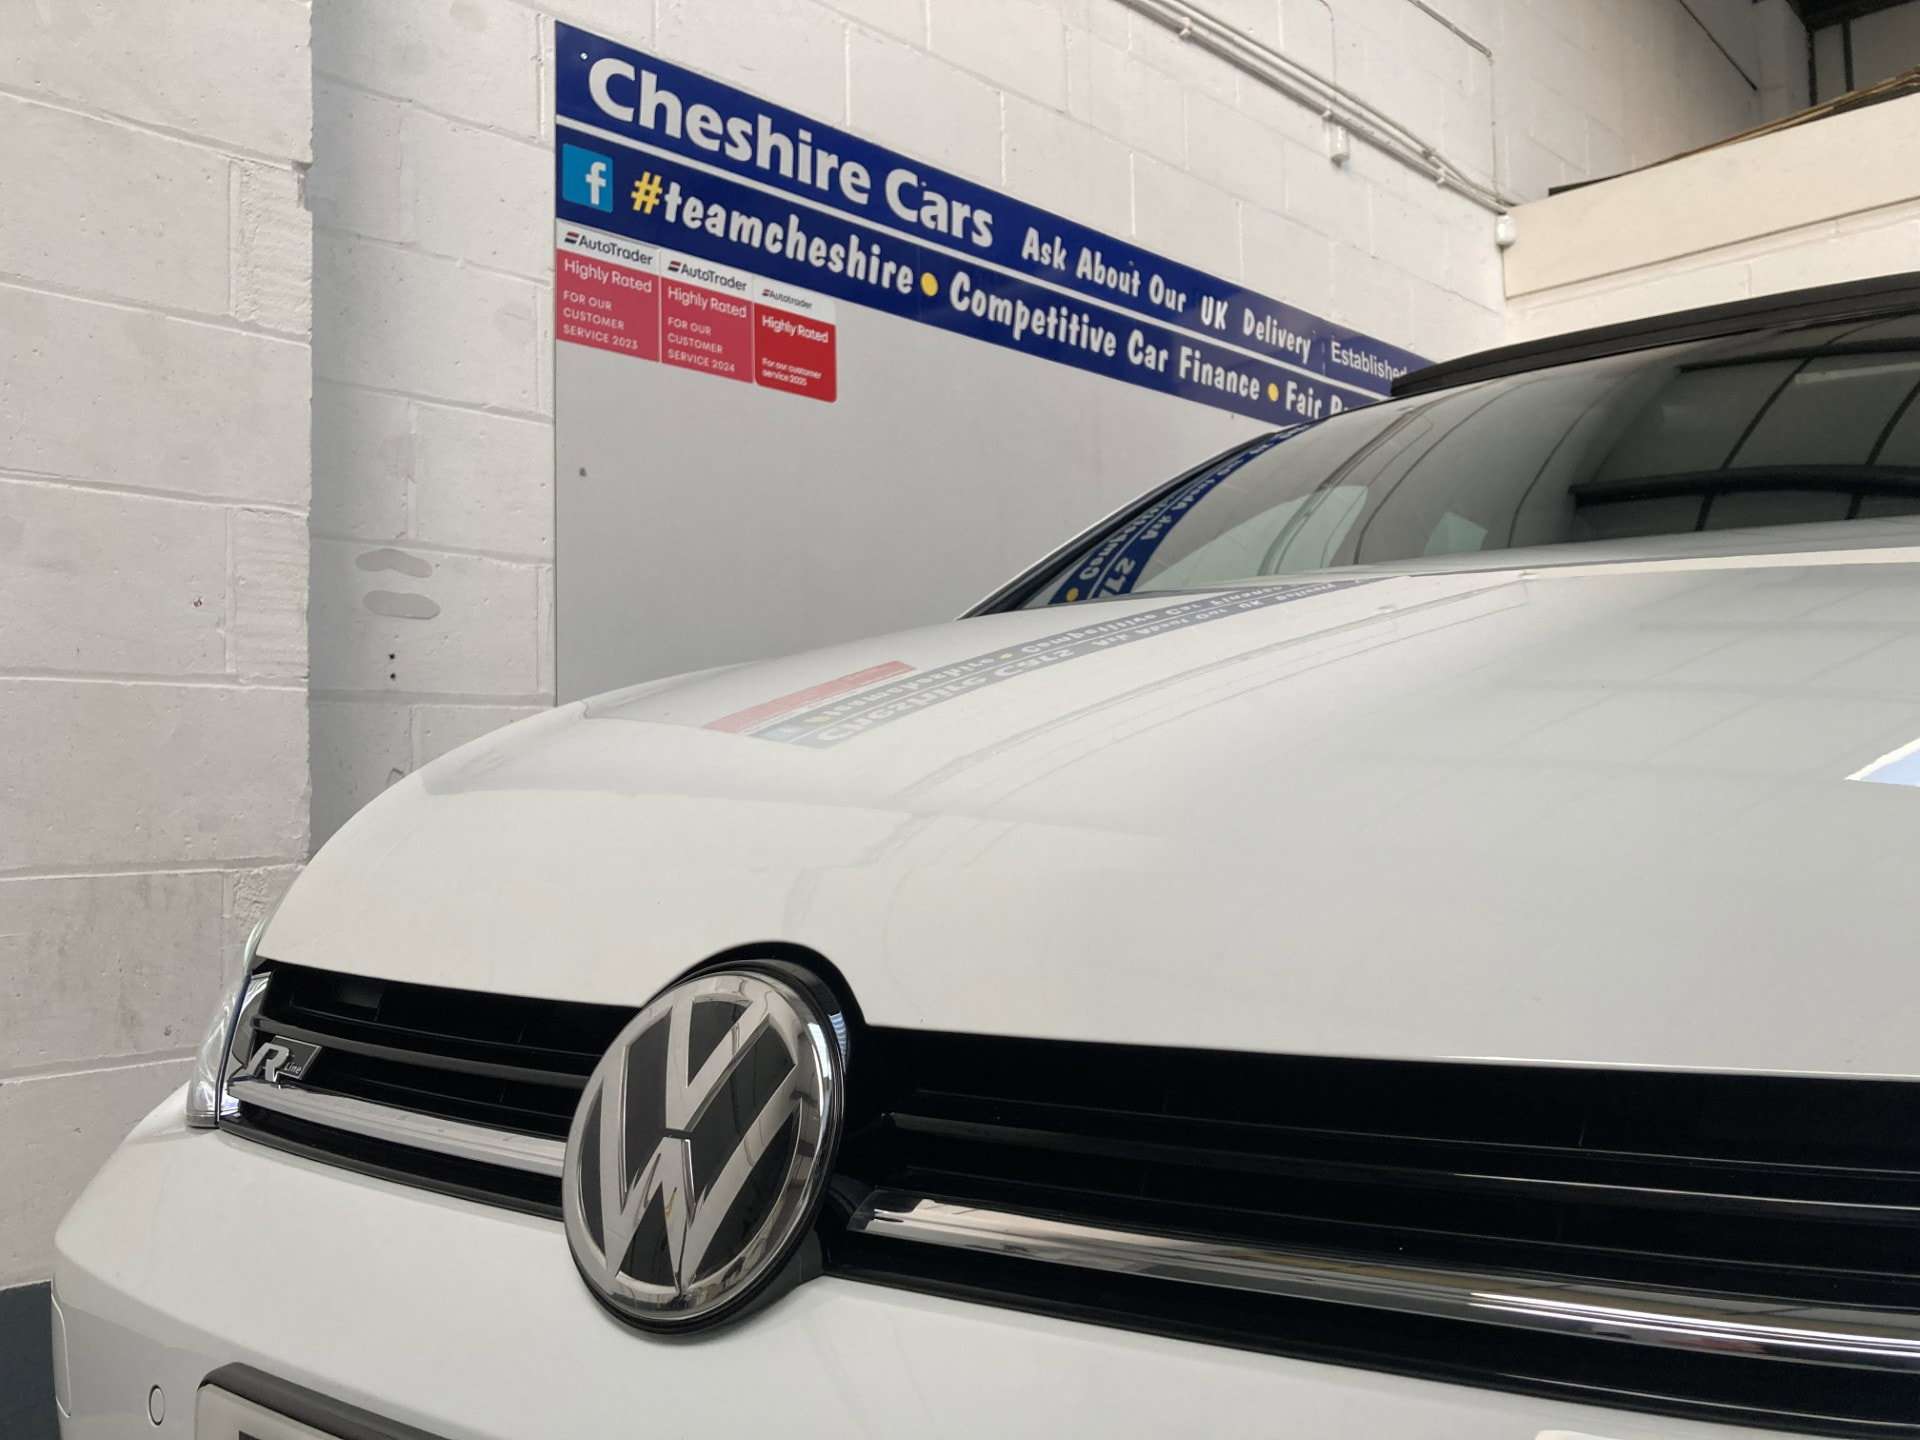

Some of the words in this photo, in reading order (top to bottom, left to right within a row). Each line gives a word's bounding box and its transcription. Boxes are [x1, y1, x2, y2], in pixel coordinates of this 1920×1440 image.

[588, 57, 871, 205] Cheshire
[885, 168, 994, 248] Cars
[585, 162, 607, 205] f
[579, 235, 653, 265] AutoTrader
[564, 258, 609, 284] Highly
[611, 271, 652, 293] Rated
[681, 264, 748, 291] AutoTrader
[563, 290, 586, 304] FOR
[588, 297, 612, 310] OUR
[631, 171, 913, 294] #teamcheshire
[949, 271, 1117, 358] Competitive
[1128, 330, 1168, 374] Car
[1180, 346, 1260, 401] Finance
[1286, 380, 1322, 419] Fair
[668, 286, 708, 310] Highly
[710, 298, 747, 318] Rated
[1021, 227, 1067, 272] Ask
[1076, 247, 1141, 298] About
[1148, 275, 1187, 313] Our
[1201, 296, 1227, 330] UK
[1243, 308, 1311, 364] Delivery
[563, 307, 624, 330] CUSTOMER
[668, 316, 688, 330] FOR
[691, 322, 712, 335] OUR
[762, 315, 796, 336] Highly
[798, 324, 828, 343] Rated
[563, 324, 609, 343] SERVICE
[668, 333, 723, 353] CUSTOMER
[668, 349, 709, 366] SERVICE
[712, 359, 735, 372] 2024
[762, 357, 775, 367] For
[776, 362, 787, 370] our
[788, 365, 822, 379] customer
[762, 369, 788, 381] service
[246, 1042, 289, 1082] R
